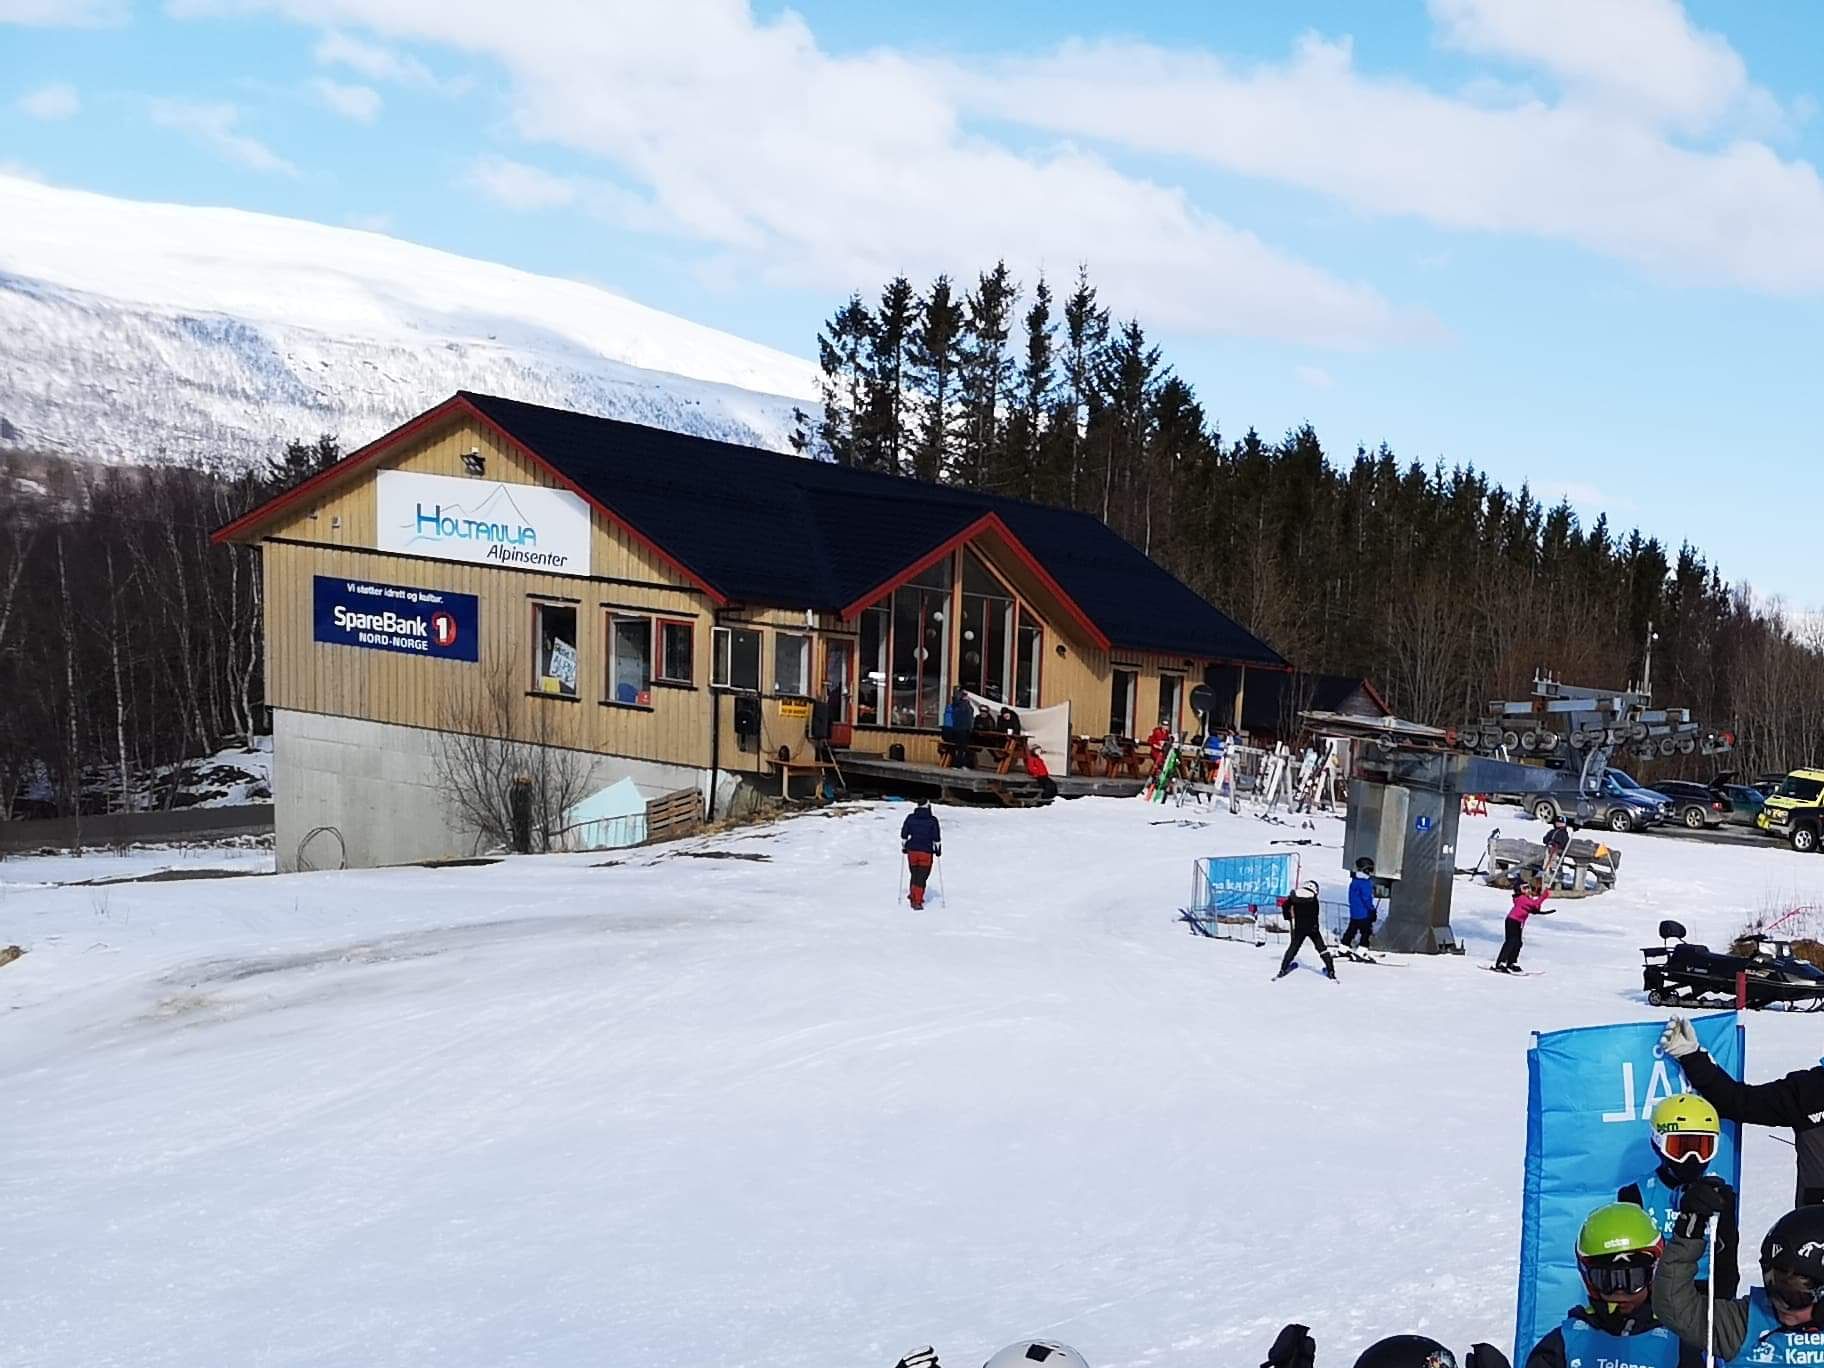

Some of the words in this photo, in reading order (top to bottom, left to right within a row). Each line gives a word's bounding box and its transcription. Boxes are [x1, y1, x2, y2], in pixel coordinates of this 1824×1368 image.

[487, 544, 568, 567] Alpinsenter
[334, 605, 428, 637] SpareBank
[436, 617, 447, 643] 1
[359, 632, 429, 651] NORD-NORGE
